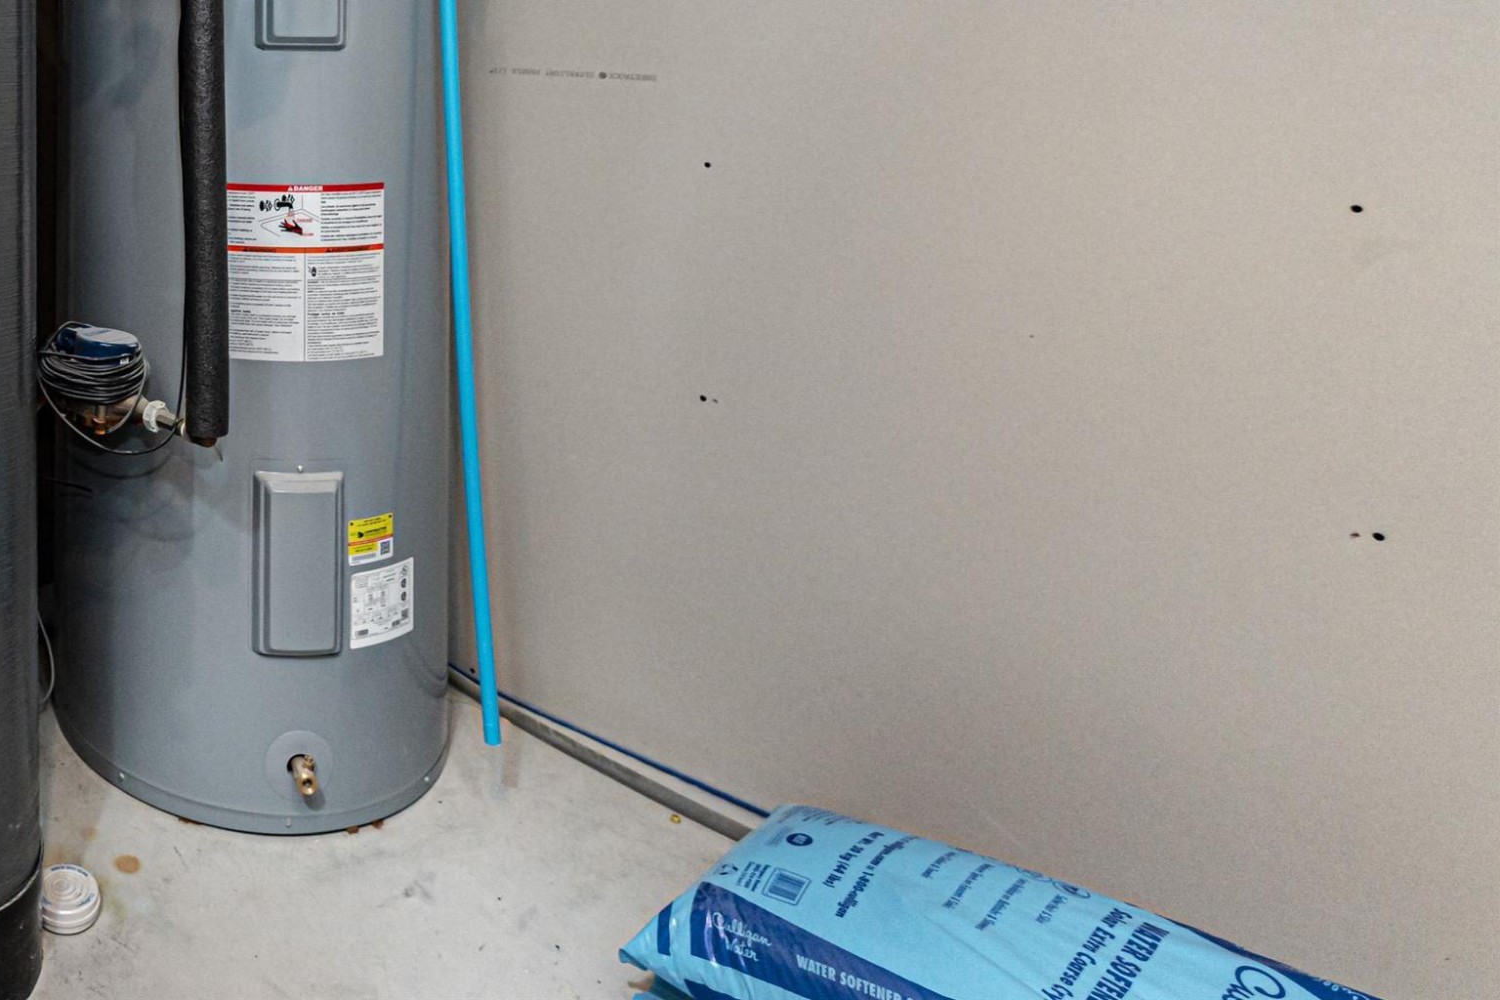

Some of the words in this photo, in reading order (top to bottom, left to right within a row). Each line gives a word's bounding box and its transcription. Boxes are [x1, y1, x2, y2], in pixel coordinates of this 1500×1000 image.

[712, 911, 773, 948] Culligan
[1101, 907, 1133, 929] Solar
[1082, 926, 1116, 953] Extra
[1121, 921, 1171, 962] WATER
[796, 953, 837, 982] WATER
[1060, 951, 1097, 986] Coarse
